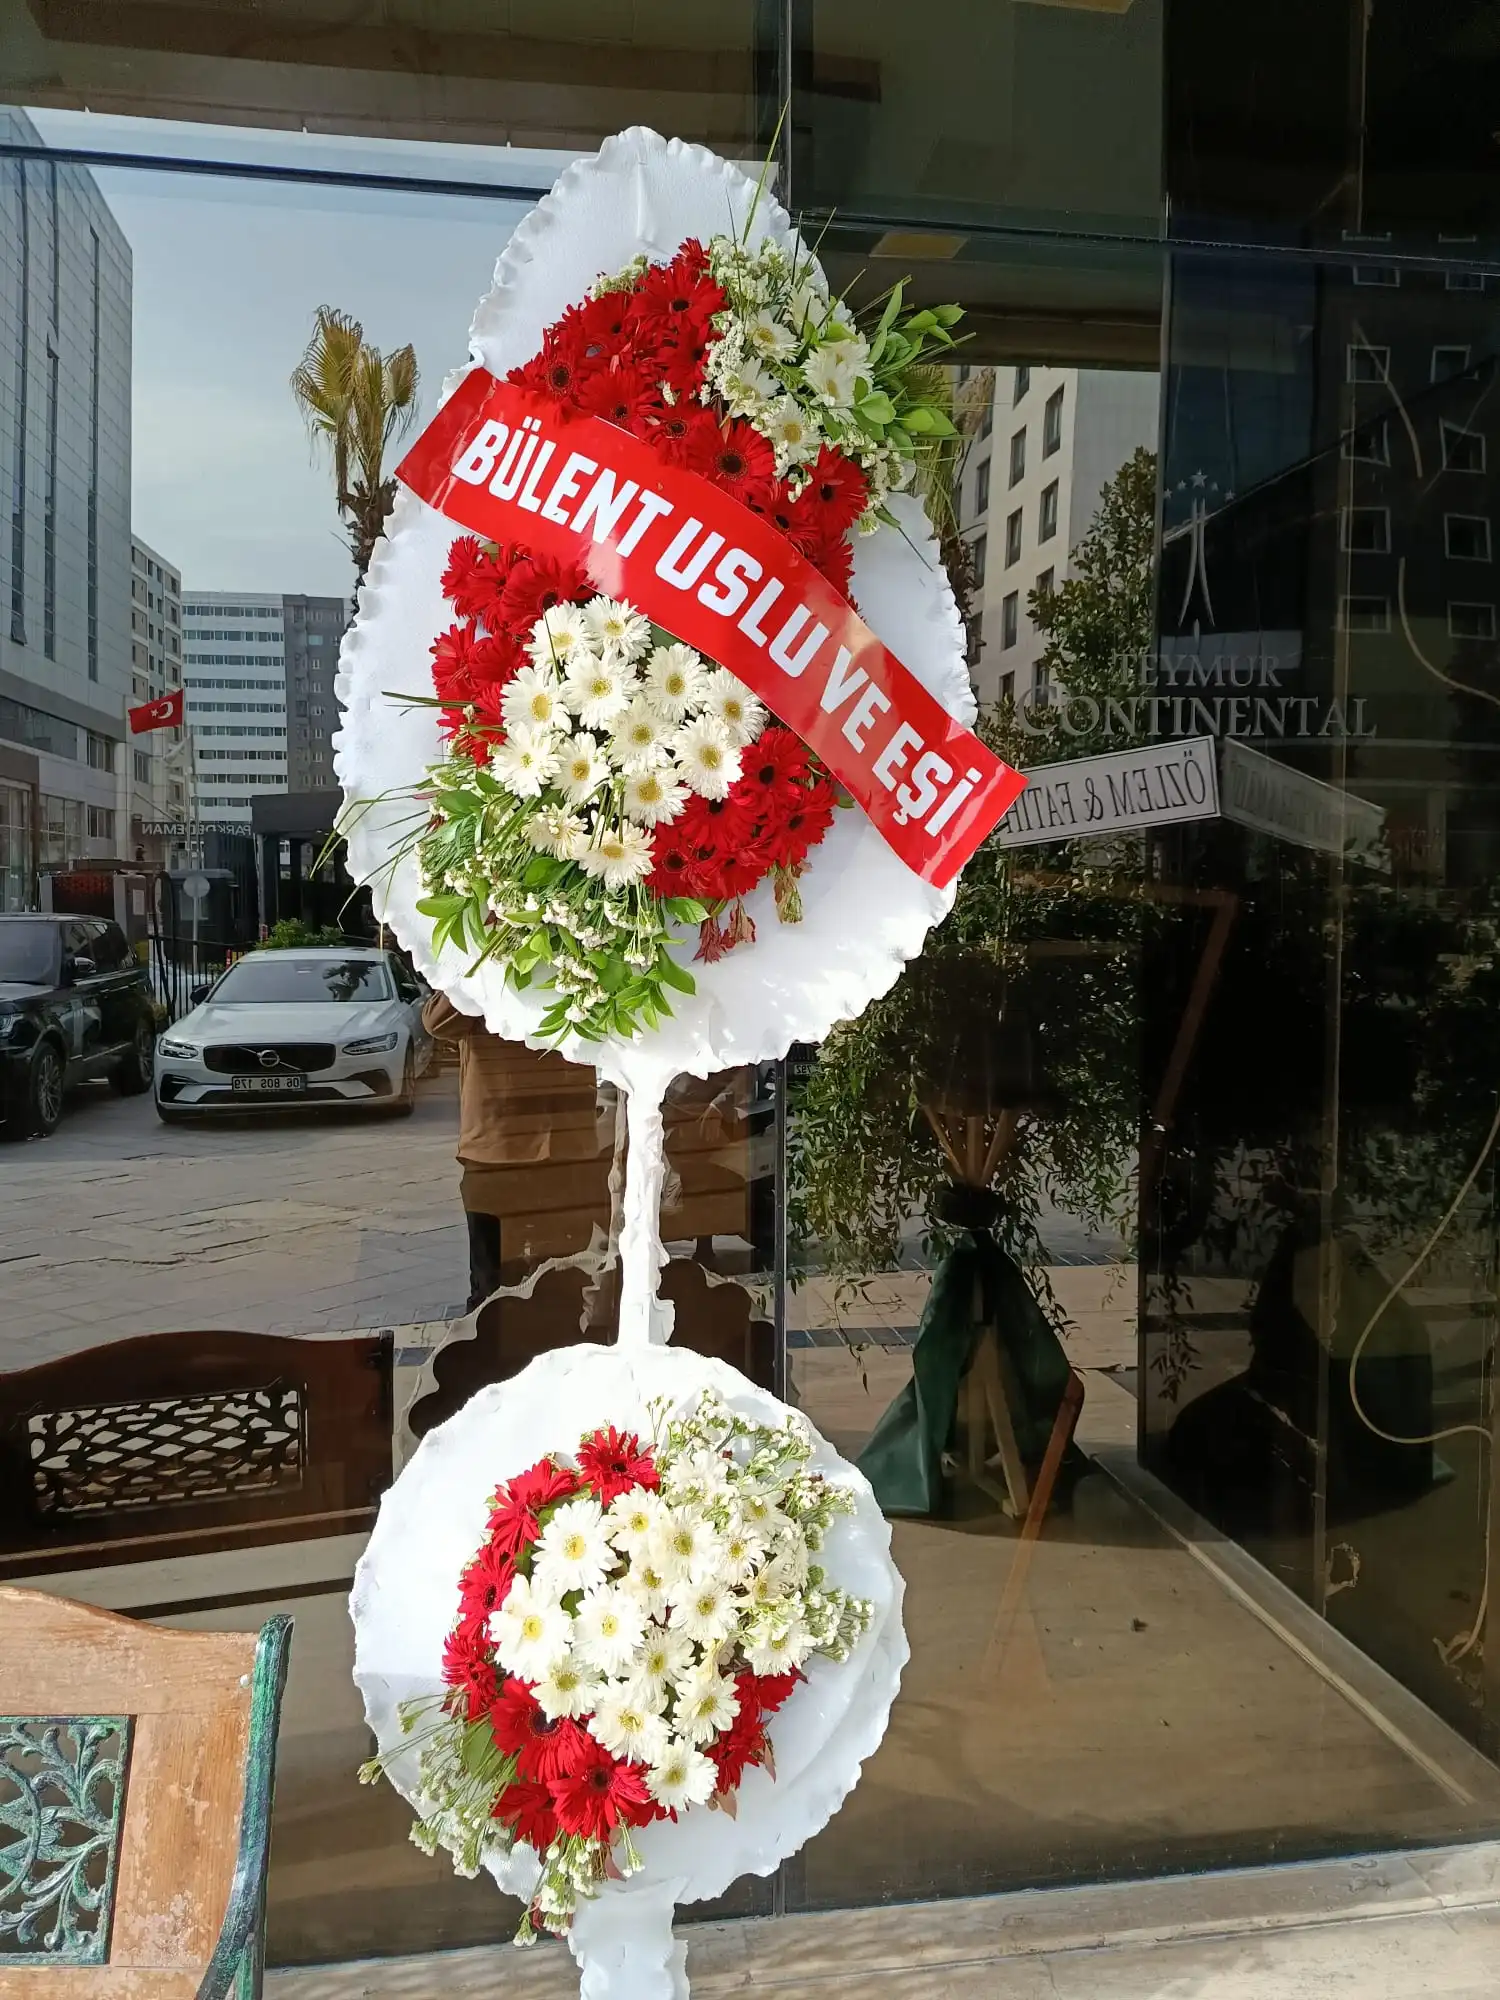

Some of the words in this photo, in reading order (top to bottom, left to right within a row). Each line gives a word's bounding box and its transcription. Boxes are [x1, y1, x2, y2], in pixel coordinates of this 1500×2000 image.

[453, 416, 674, 558] BÜLENT
[655, 517, 834, 679] USLU
[819, 644, 893, 754] VE
[871, 720, 982, 838] EŞİ
[1112, 653, 1283, 688] TEYMUR
[1017, 684, 1377, 737] CONTINENTAL
